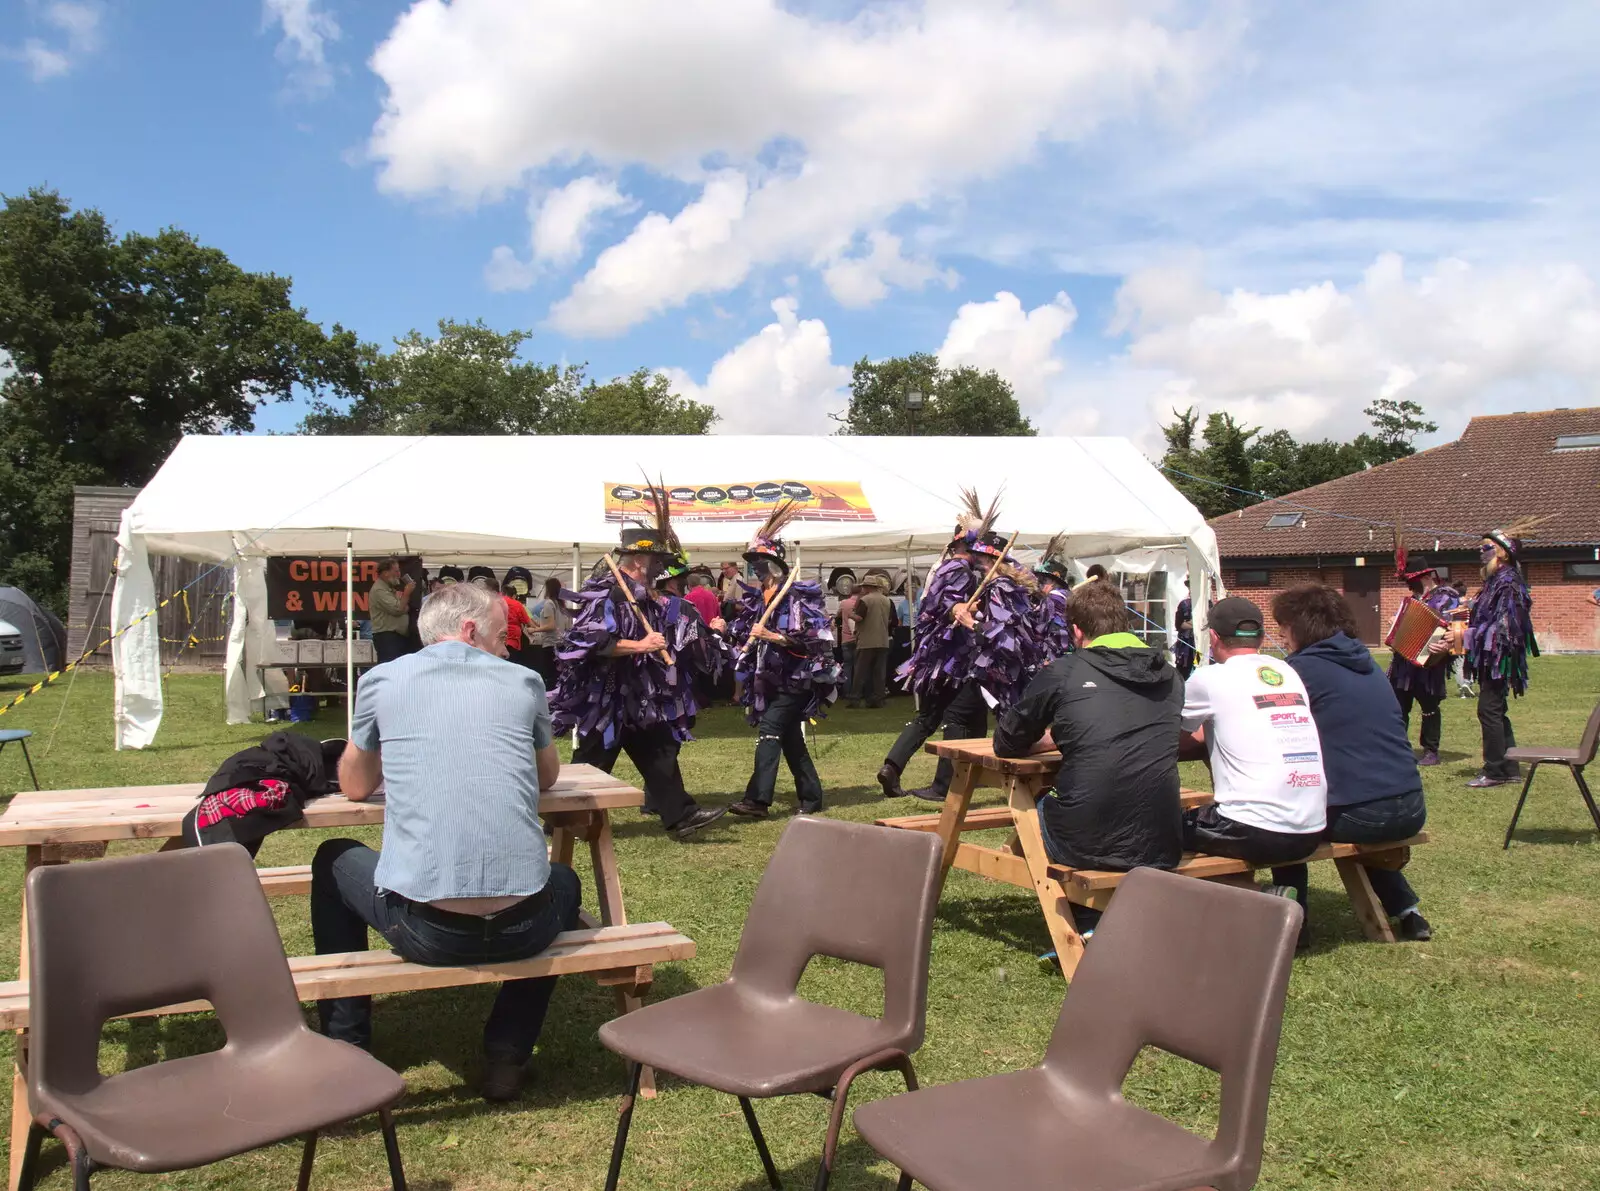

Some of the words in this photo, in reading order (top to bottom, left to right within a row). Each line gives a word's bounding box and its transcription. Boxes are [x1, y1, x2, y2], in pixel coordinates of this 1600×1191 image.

[285, 591, 303, 611] &
[312, 591, 370, 611] WIN
[1270, 712, 1296, 721] SPORT
